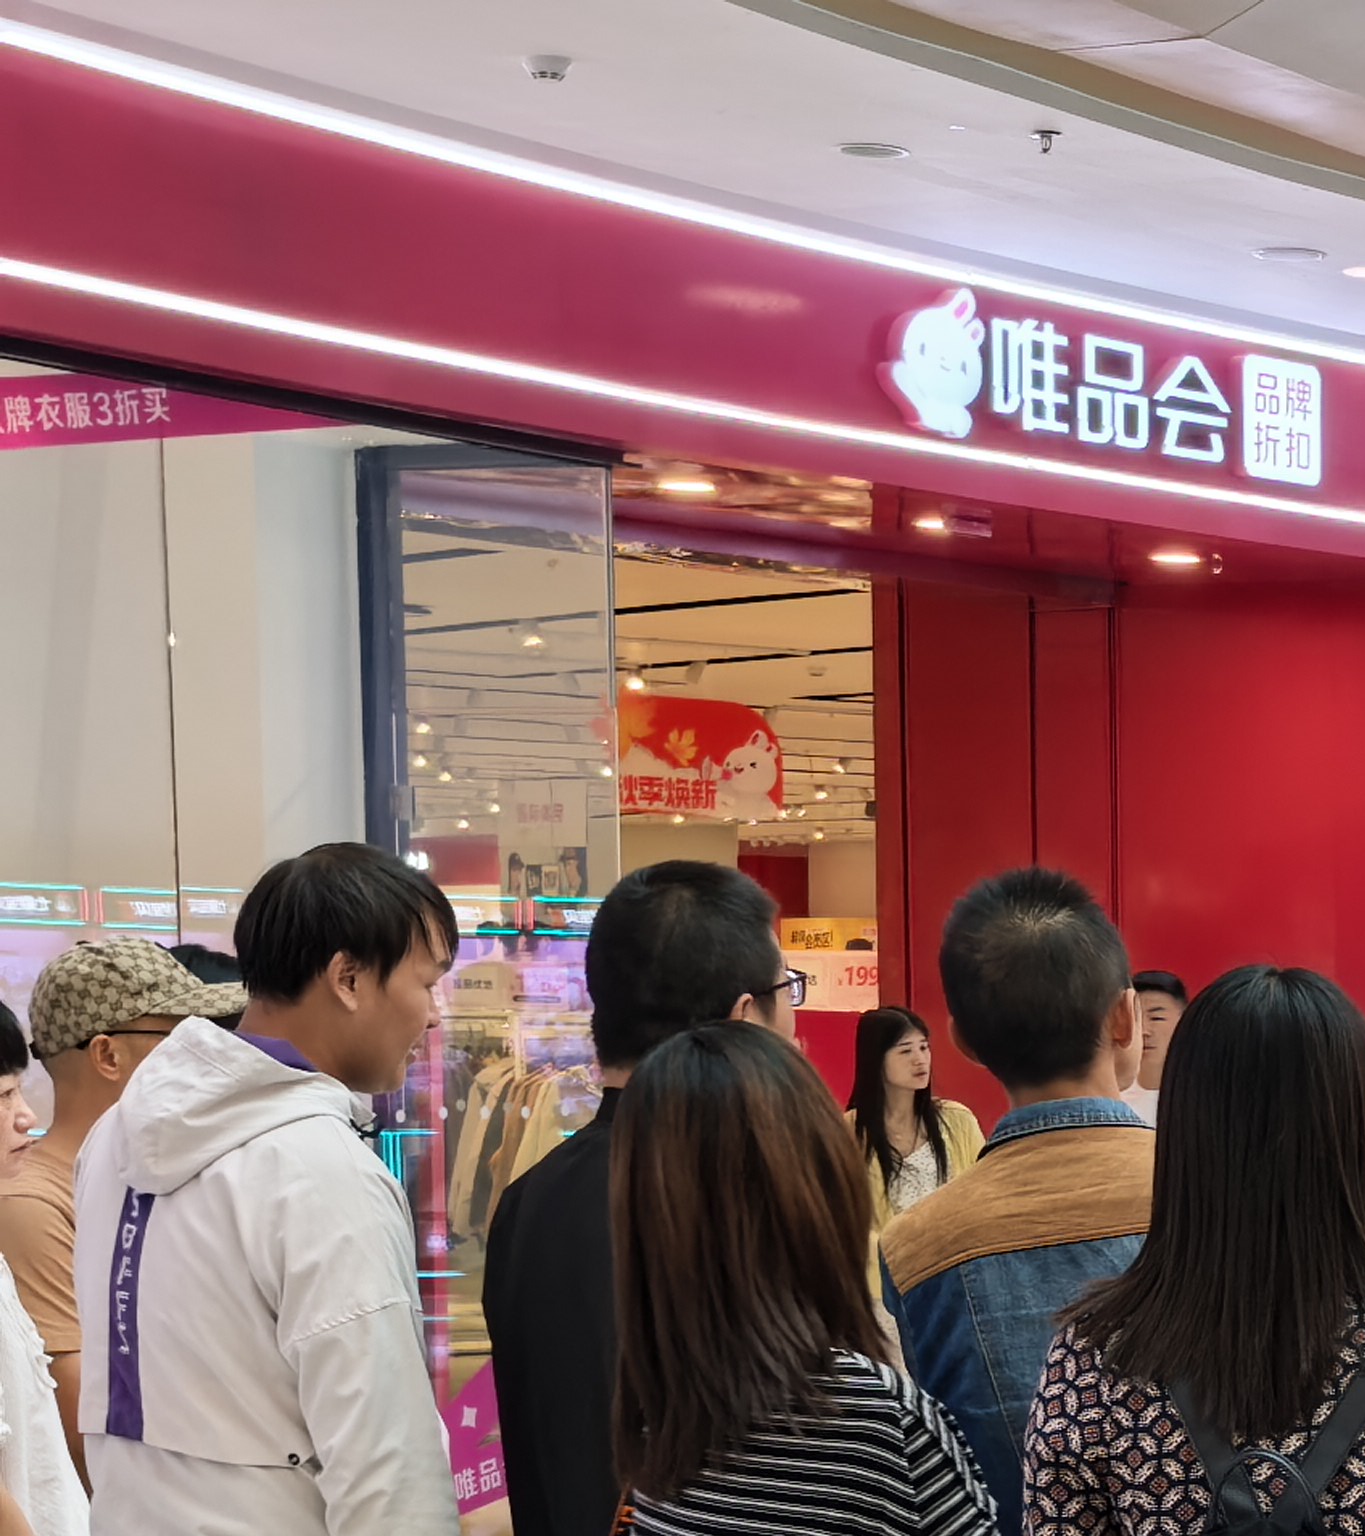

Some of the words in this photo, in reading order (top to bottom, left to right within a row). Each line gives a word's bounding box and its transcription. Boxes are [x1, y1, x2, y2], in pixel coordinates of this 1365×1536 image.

[0, 387, 172, 434] 牌衣服3折买
[990, 318, 1232, 463] 唯品会
[1255, 372, 1313, 422] 品牌
[1254, 422, 1311, 470] 折扣
[455, 1458, 507, 1500] 唯品
